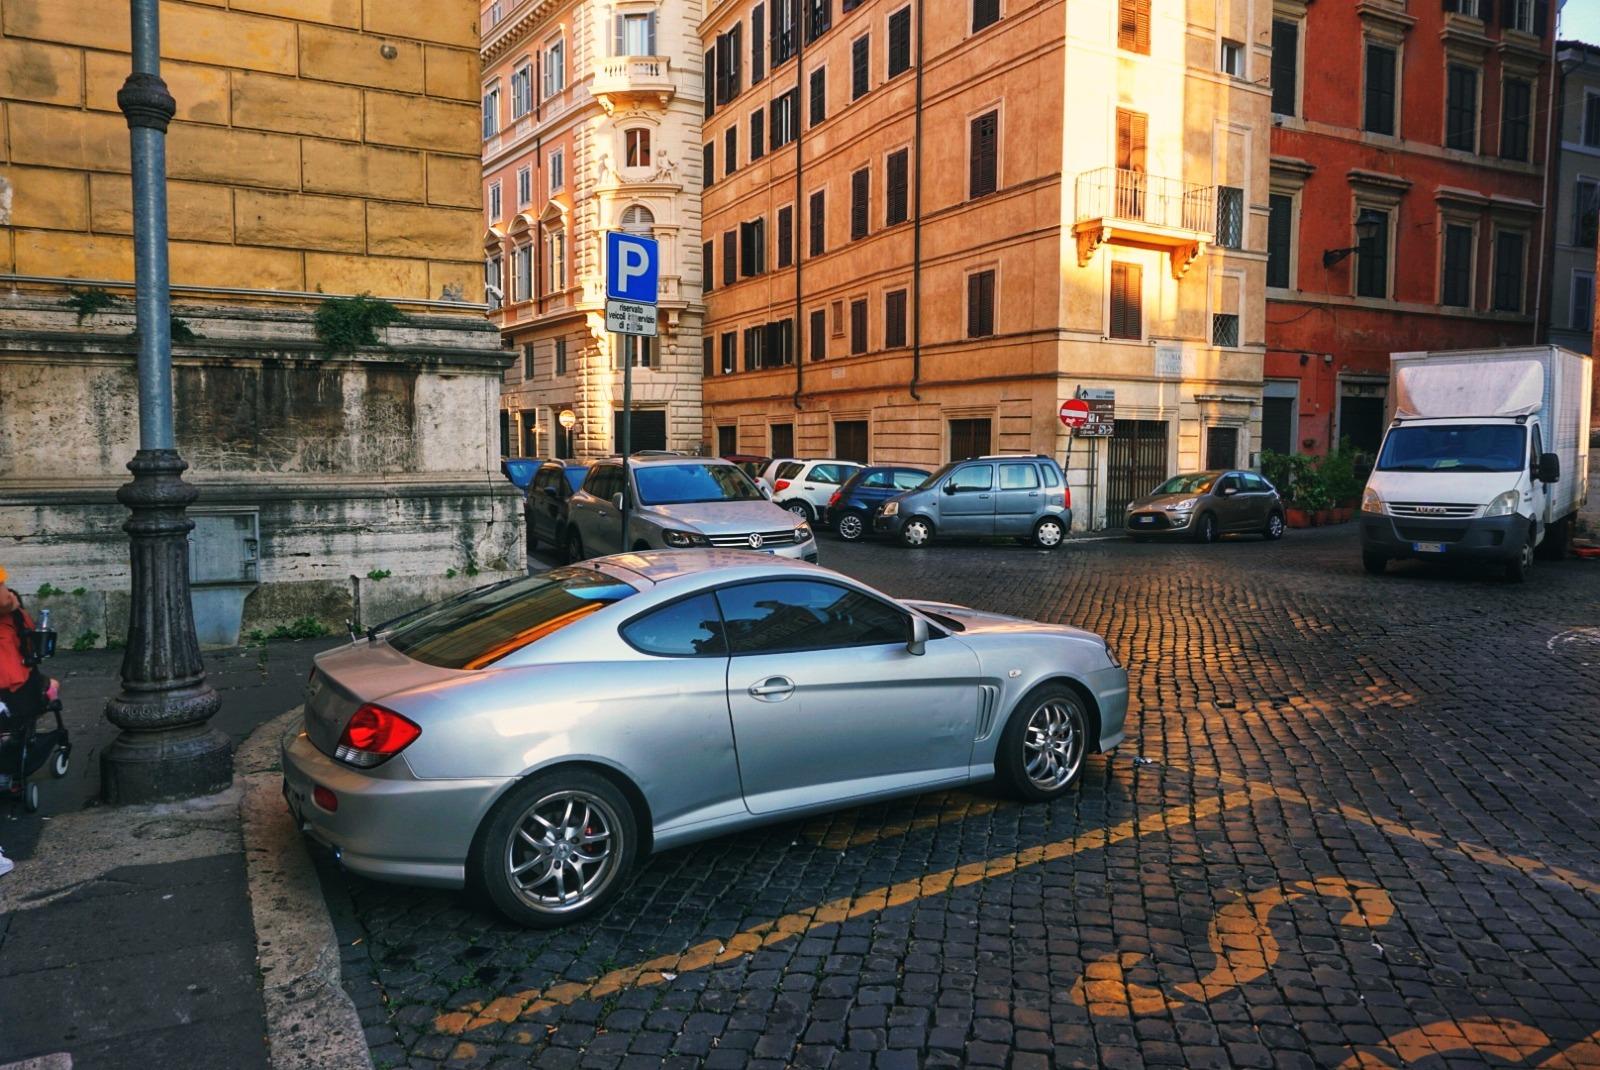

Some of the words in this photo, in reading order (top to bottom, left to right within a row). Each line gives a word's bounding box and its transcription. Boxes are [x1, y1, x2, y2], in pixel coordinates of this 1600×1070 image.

[618, 240, 649, 293] P
[619, 304, 643, 314] riservato
[608, 311, 626, 320] veicoli
[637, 314, 656, 324] ervizio
[618, 320, 625, 329] di
[1415, 506, 1447, 514] IVECO
